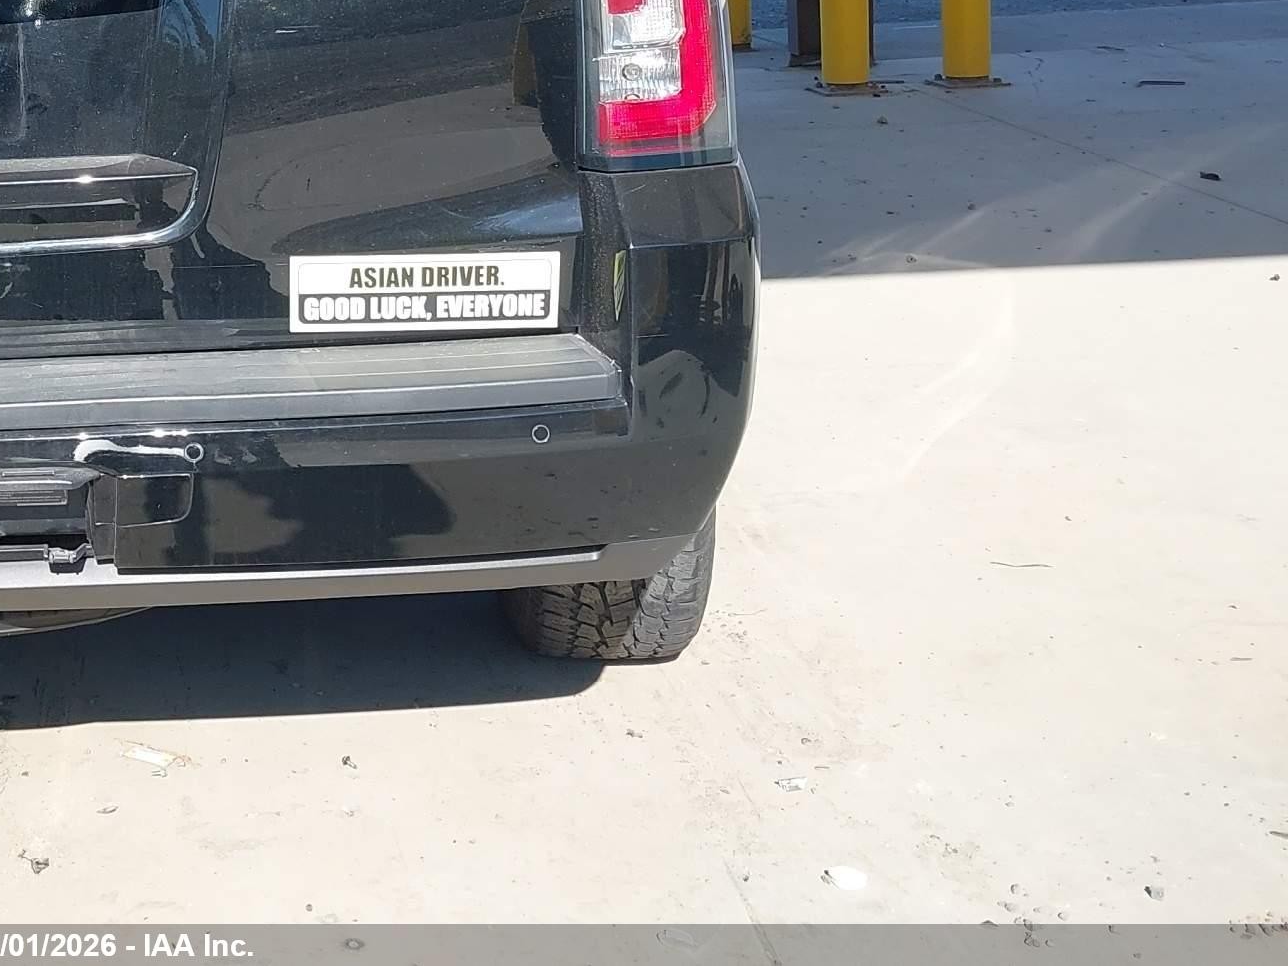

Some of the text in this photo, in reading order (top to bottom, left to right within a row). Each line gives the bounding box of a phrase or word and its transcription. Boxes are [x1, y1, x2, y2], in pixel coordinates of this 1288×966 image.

[349, 264, 505, 288] ASIAN DRIVER.
[303, 293, 545, 321] GOOD LUCK, EVERYONE
